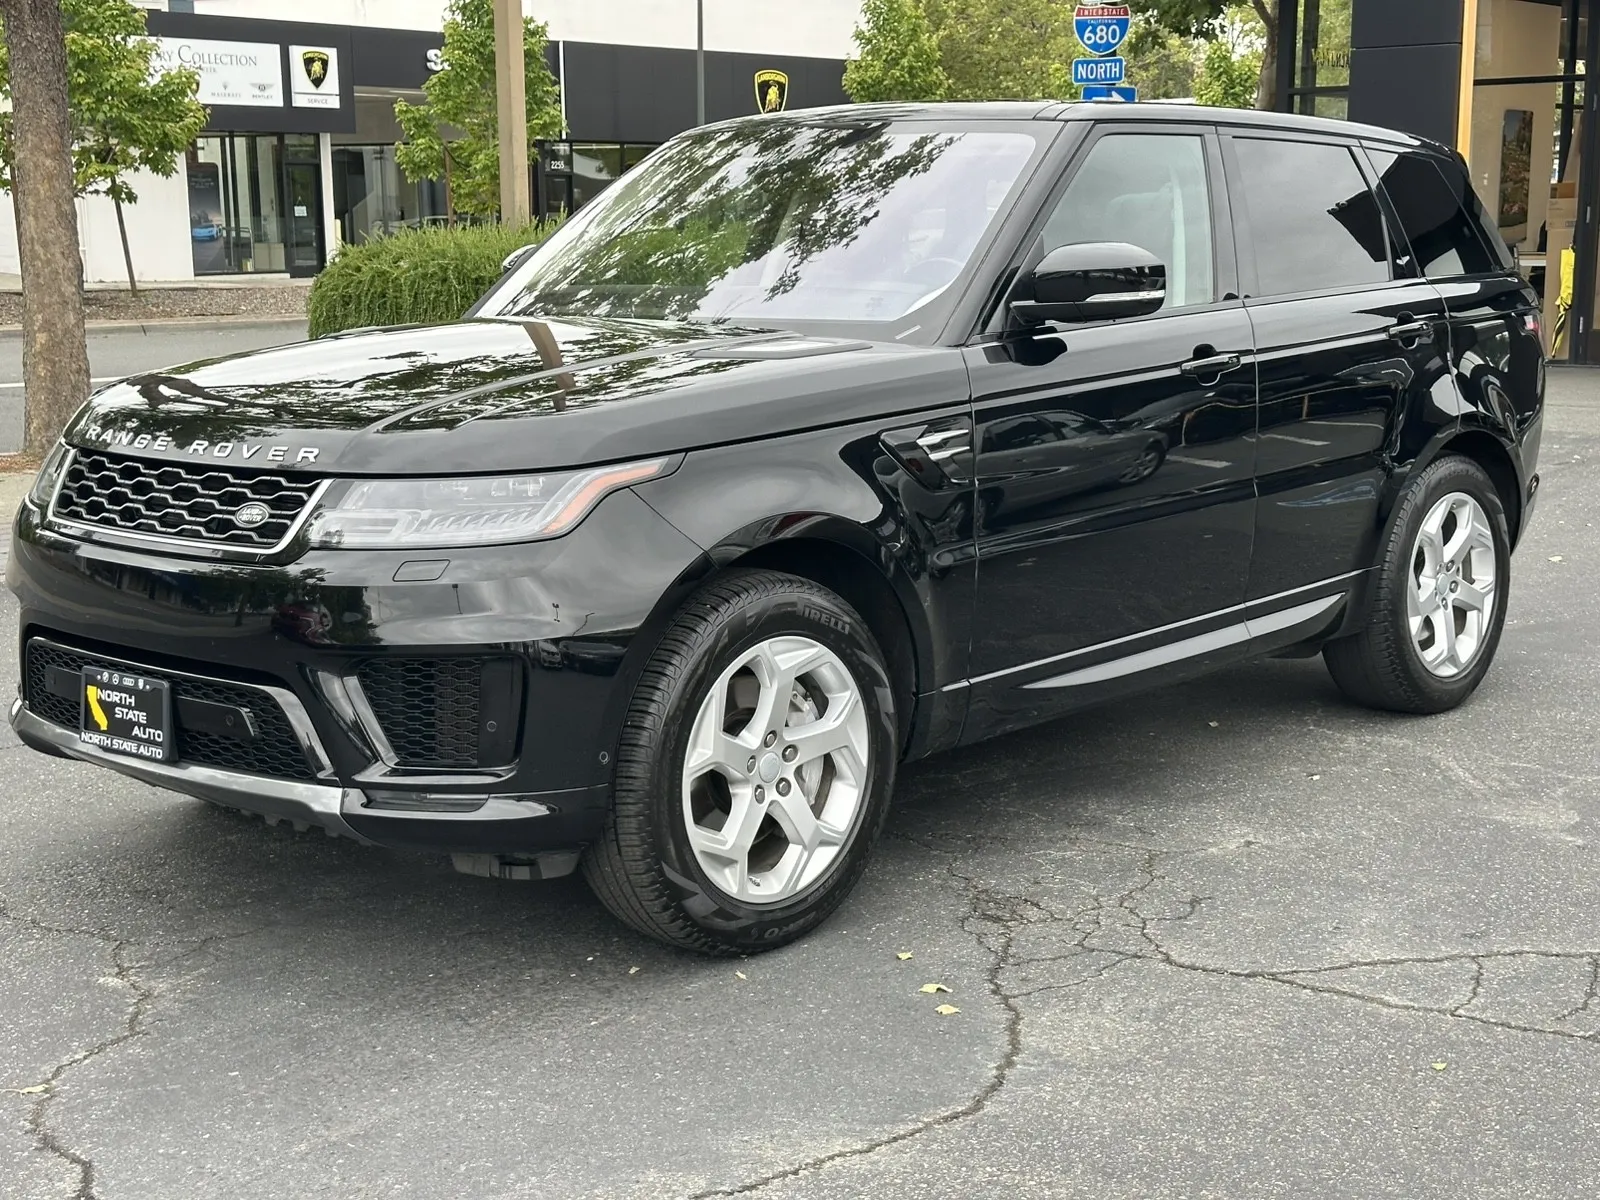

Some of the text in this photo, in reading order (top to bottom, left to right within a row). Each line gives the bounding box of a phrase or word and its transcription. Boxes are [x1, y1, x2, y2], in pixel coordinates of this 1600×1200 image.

[1080, 8, 1125, 16] INTERSTATE
[1083, 25, 1120, 45] 680
[178, 44, 258, 67] COLLECTION
[1077, 62, 1120, 80] NORTH
[85, 426, 321, 463] RANGE ROVER
[796, 596, 850, 635] PIRELLI
[97, 688, 135, 707] NORTH
[114, 706, 147, 724] STATE
[131, 725, 163, 742] AUTO
[81, 731, 163, 759] NORTH STATE AUTO
